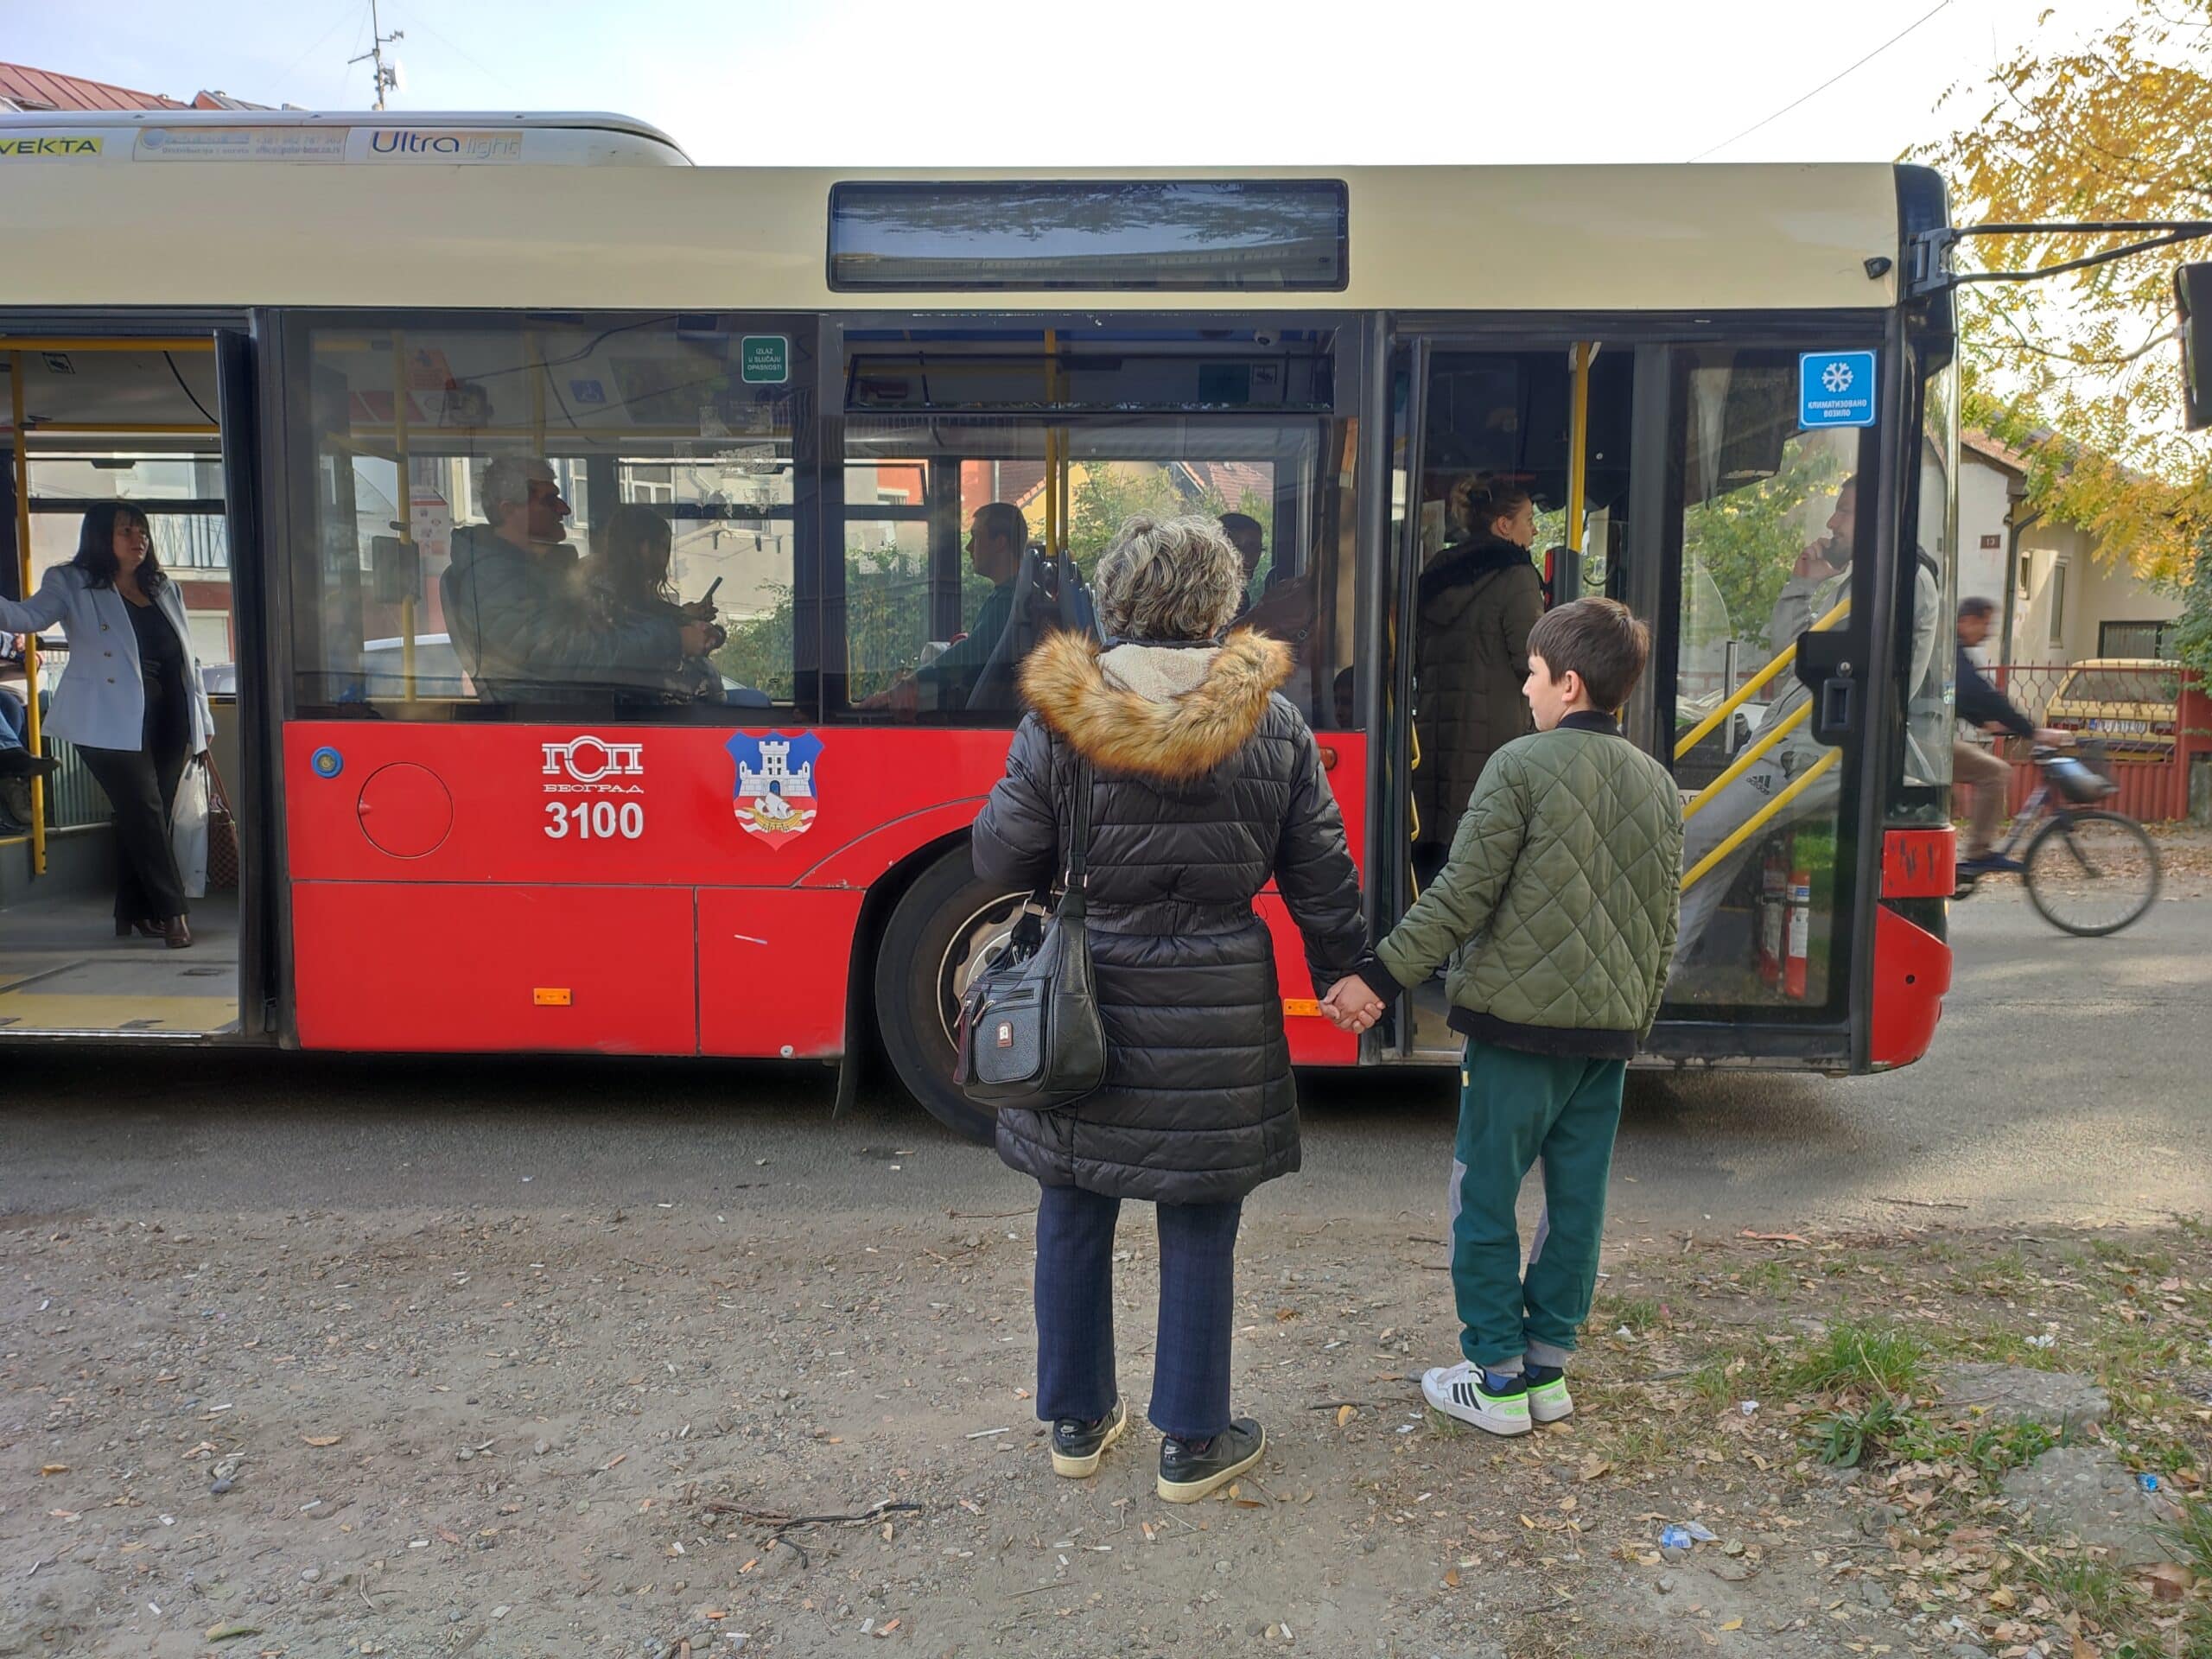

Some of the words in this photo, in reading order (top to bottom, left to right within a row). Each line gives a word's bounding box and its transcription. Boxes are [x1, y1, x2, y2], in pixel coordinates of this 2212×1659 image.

[372, 131, 460, 153] Ultra
[466, 137, 519, 159] light
[754, 354, 781, 363] SLUČAJU
[1808, 399, 1867, 409] КЛИМАТИЗОВАНО
[1823, 410, 1851, 418] ВОЗИЛО
[542, 735, 643, 783] ГСП
[543, 784, 645, 794] БЕОГРАД
[543, 801, 644, 840] 3100
